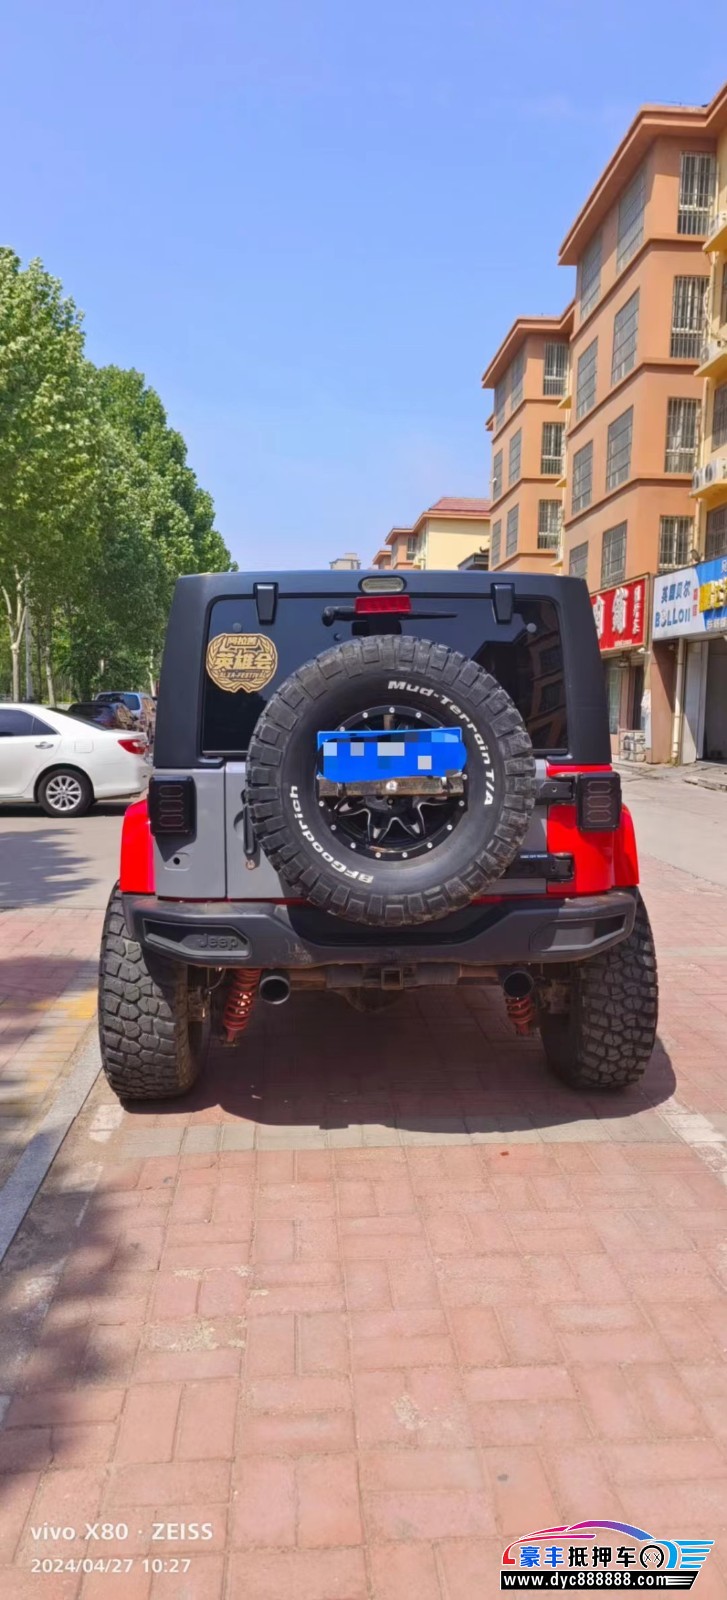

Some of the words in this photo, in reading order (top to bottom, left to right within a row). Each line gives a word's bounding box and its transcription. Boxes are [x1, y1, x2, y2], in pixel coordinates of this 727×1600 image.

[213, 648, 273, 670] 英雄会
[387, 680, 491, 765] Mud-Terrain
[484, 768, 495, 806] T/A
[289, 785, 375, 884] BFGoodrich
[197, 933, 239, 951] Jeep
